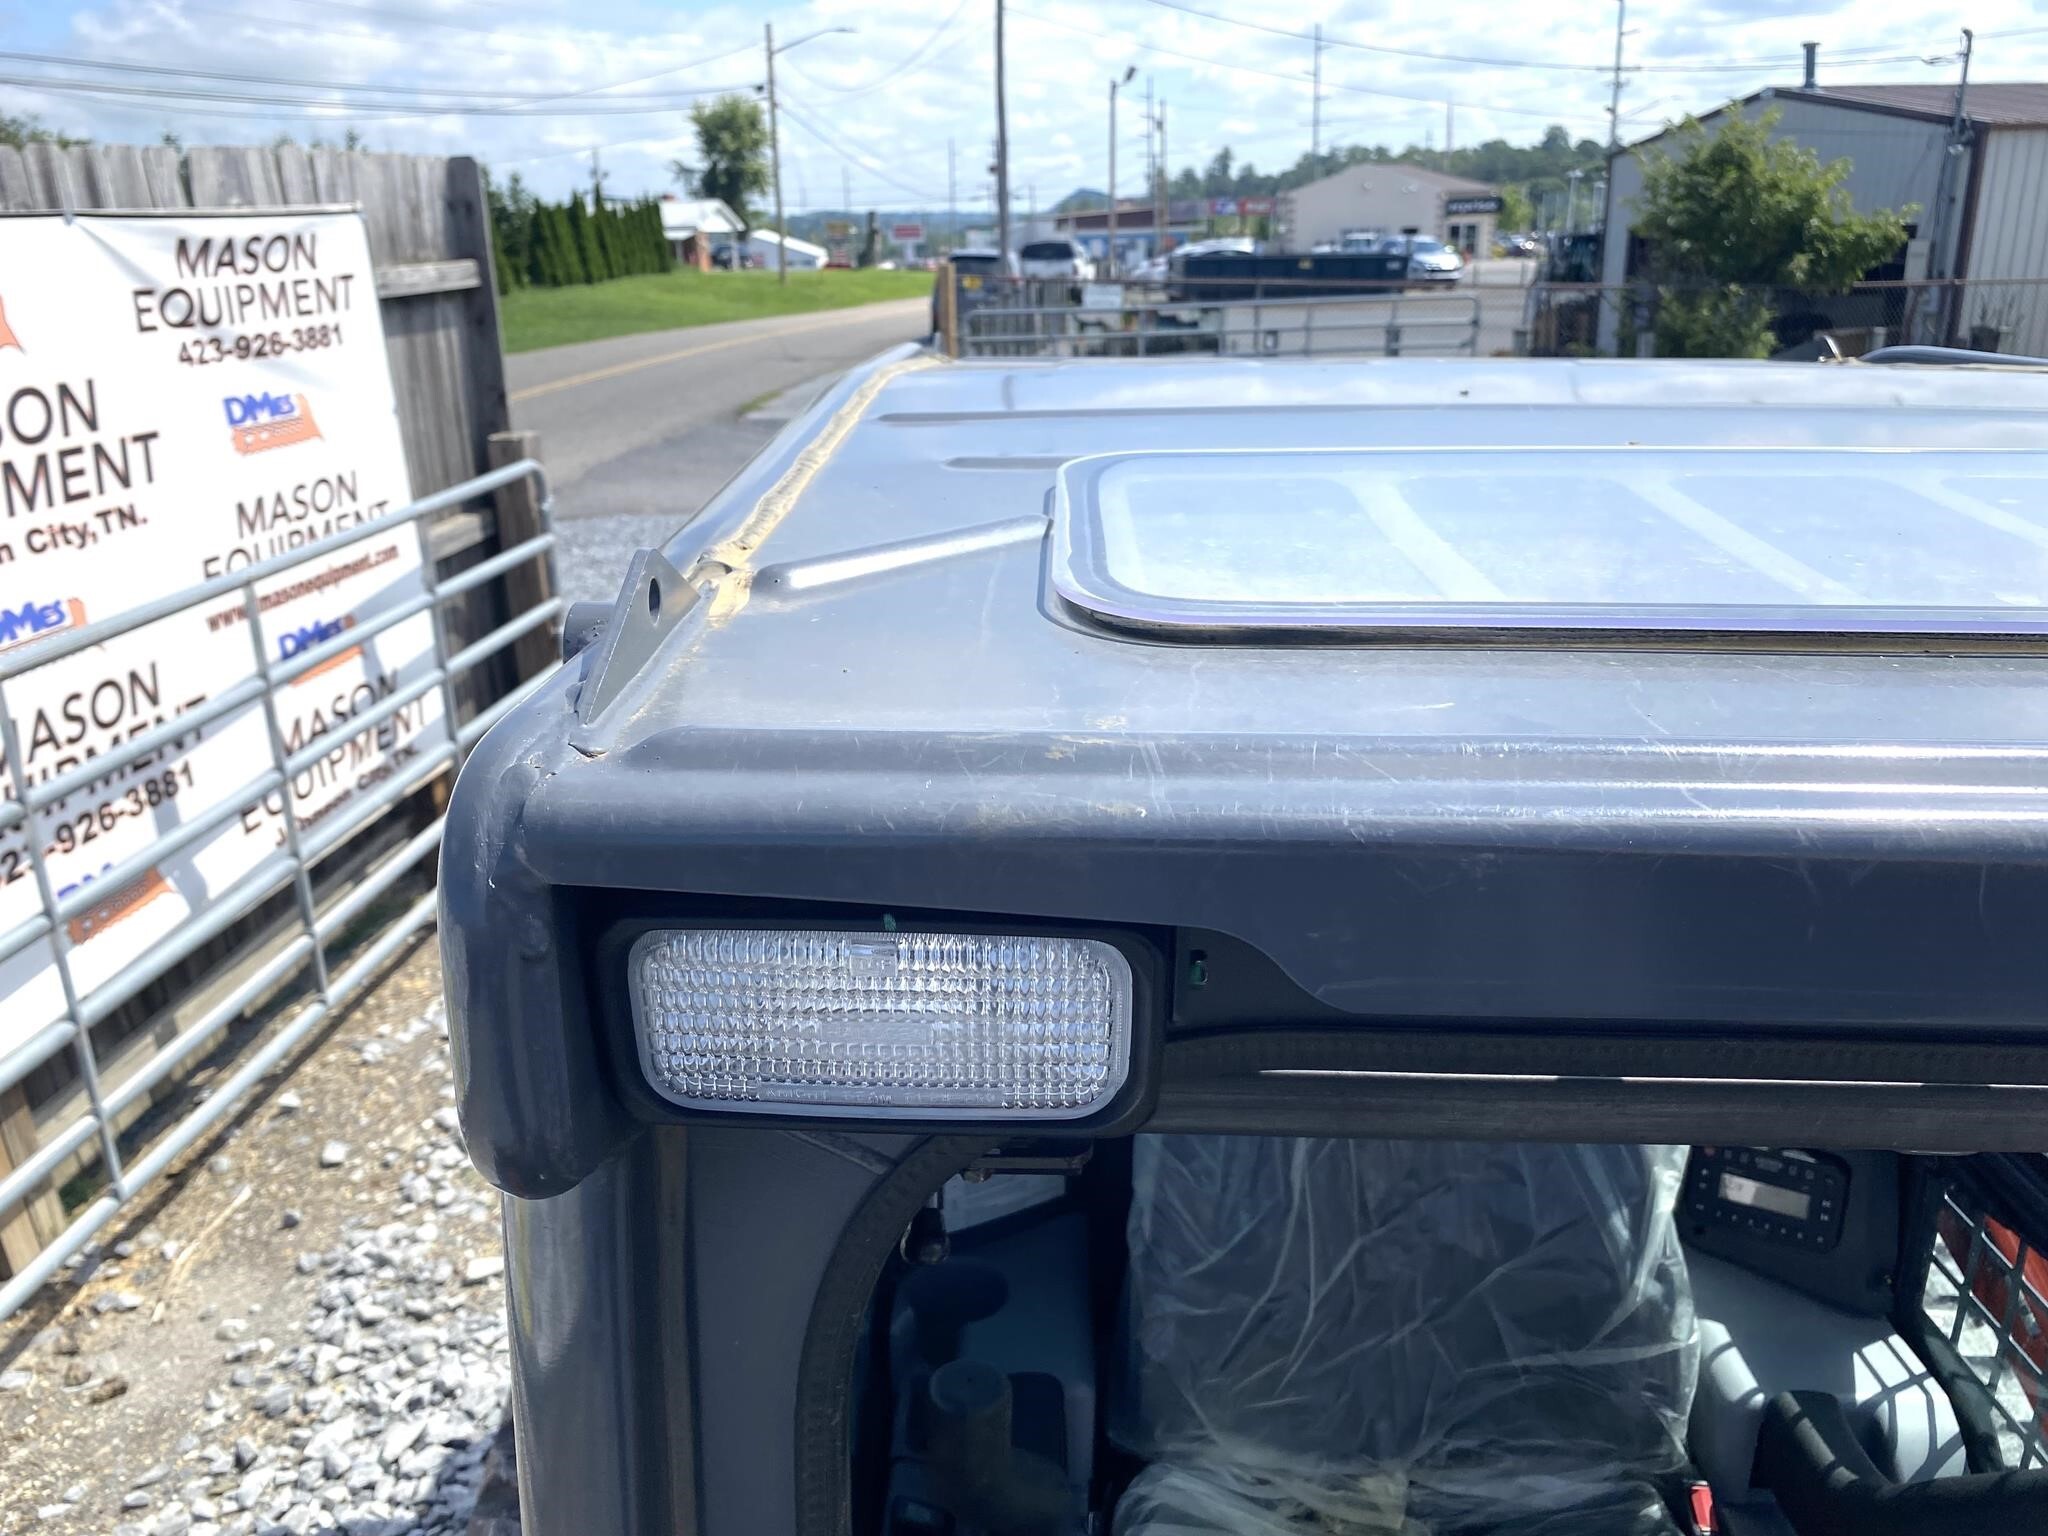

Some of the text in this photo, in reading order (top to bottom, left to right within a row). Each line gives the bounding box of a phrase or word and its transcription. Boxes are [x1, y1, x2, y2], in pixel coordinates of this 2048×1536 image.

[175, 233, 317, 279] MASON
[133, 274, 355, 333] EQUIPMENT
[178, 323, 343, 366] 423-926-3881
[0, 378, 99, 446] ON
[236, 469, 358, 539] MASON
[0, 662, 161, 776] ASON
